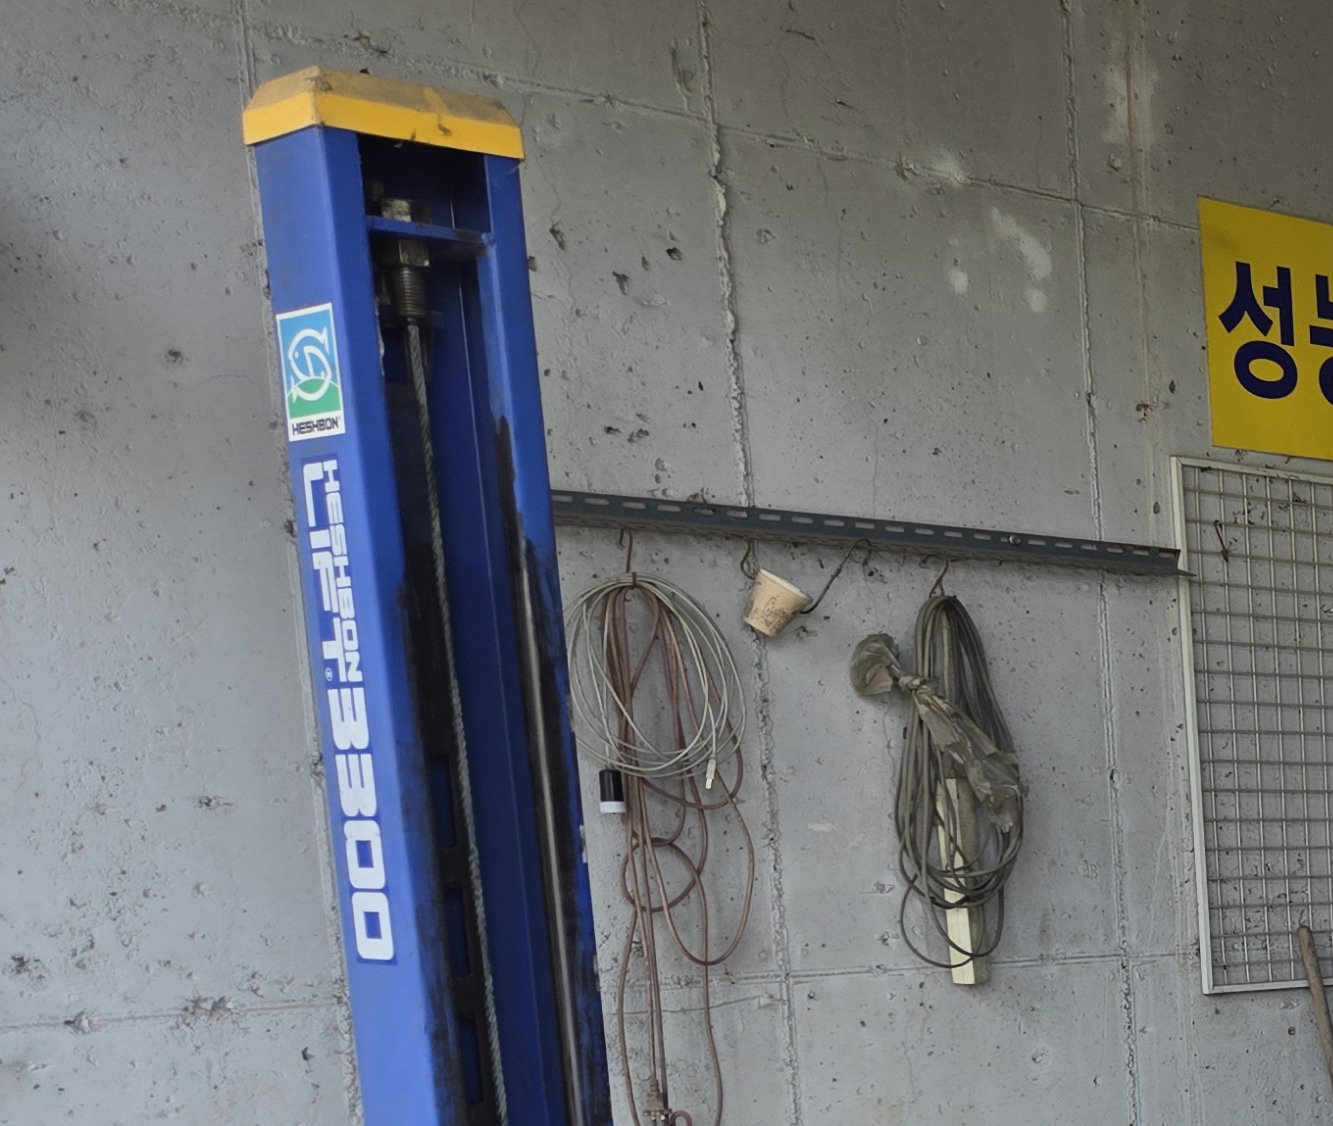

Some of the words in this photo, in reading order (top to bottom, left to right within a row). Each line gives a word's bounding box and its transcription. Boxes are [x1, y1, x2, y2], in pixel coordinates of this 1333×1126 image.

[292, 416, 340, 437] HESHBON
[323, 459, 364, 682] HESHBON
[328, 685, 395, 962] 3300
